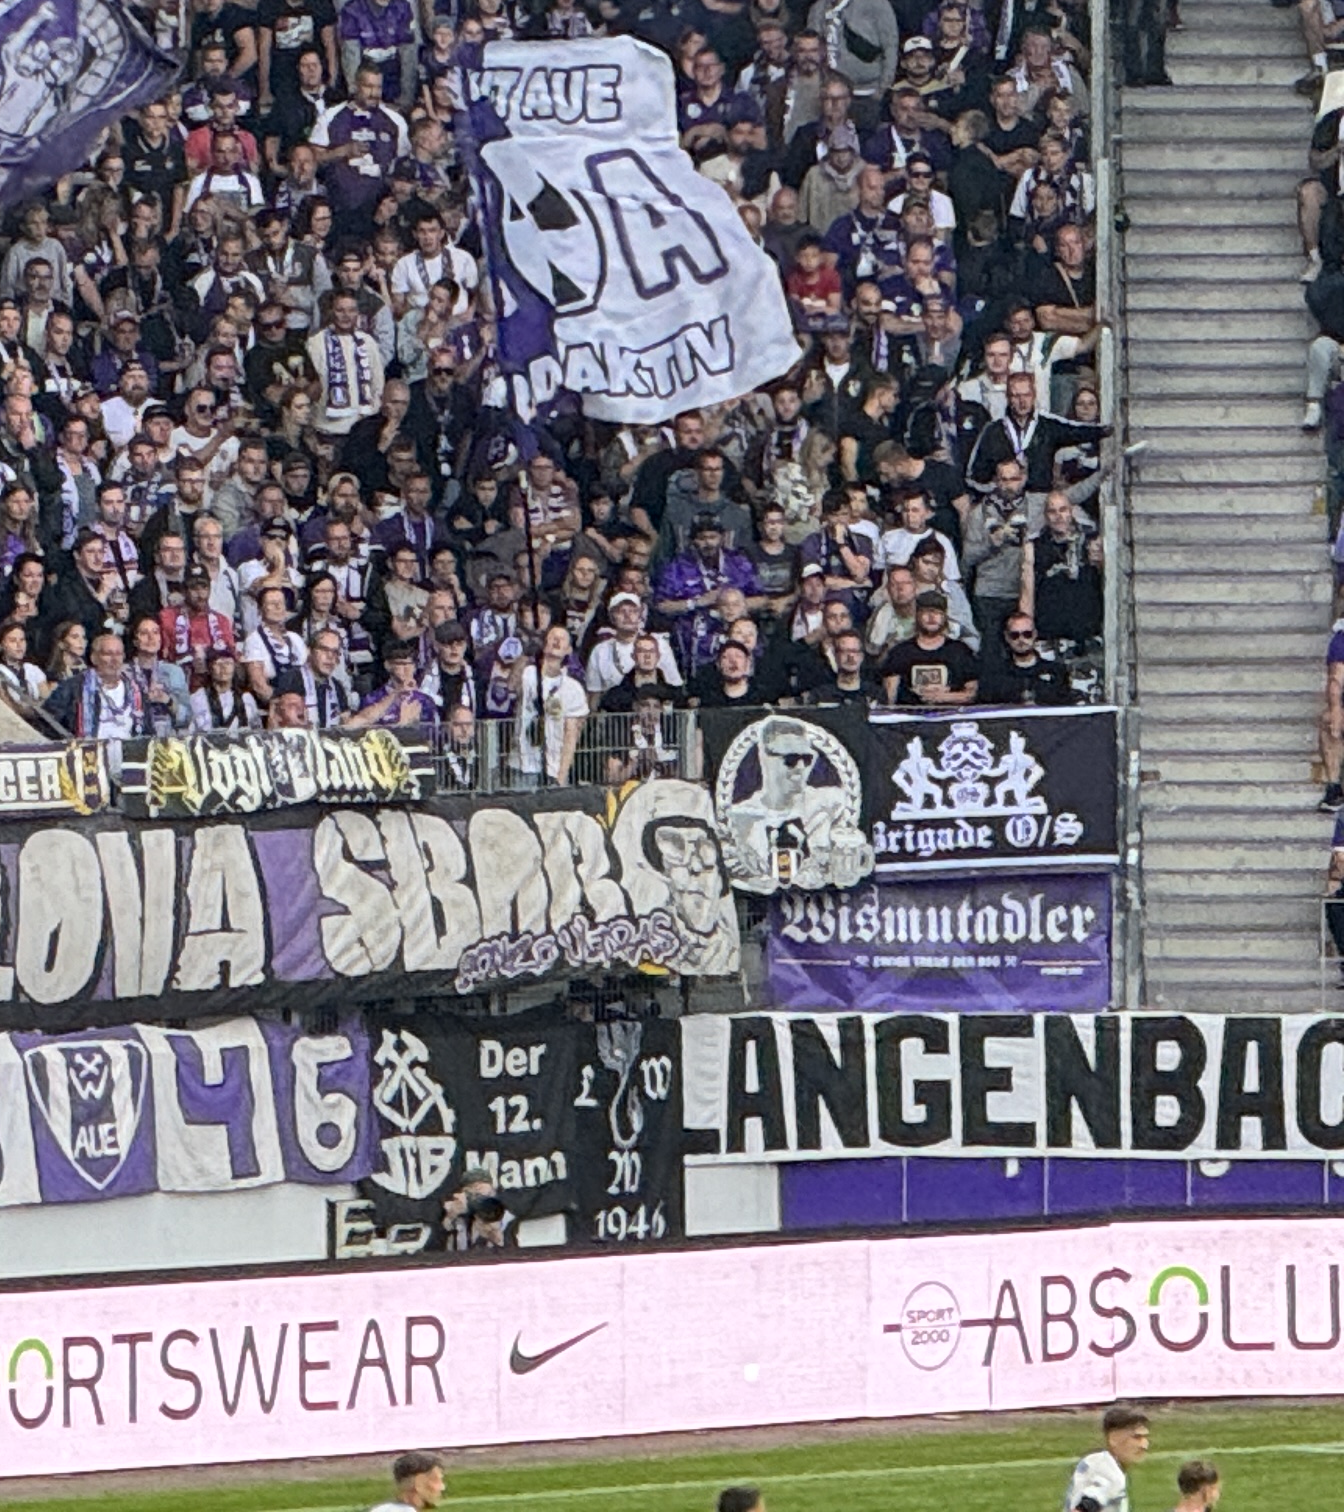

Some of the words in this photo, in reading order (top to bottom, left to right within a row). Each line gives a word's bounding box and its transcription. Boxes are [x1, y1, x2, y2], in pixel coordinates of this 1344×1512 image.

[520, 63, 623, 125] AUE
[562, 314, 736, 400] AKTIV
[872, 818, 994, 857] Brigade
[1004, 811, 1084, 849] O/S
[779, 891, 1097, 946] Wismutadler
[478, 1038, 547, 1079] Der
[487, 1094, 543, 1135] 12.
[465, 1149, 568, 1192] Mann
[594, 1200, 667, 1242] 1946
[906, 1307, 955, 1325] SPORT
[911, 1328, 950, 1345] 2000
[982, 1264, 1341, 1367] ABSOLU
